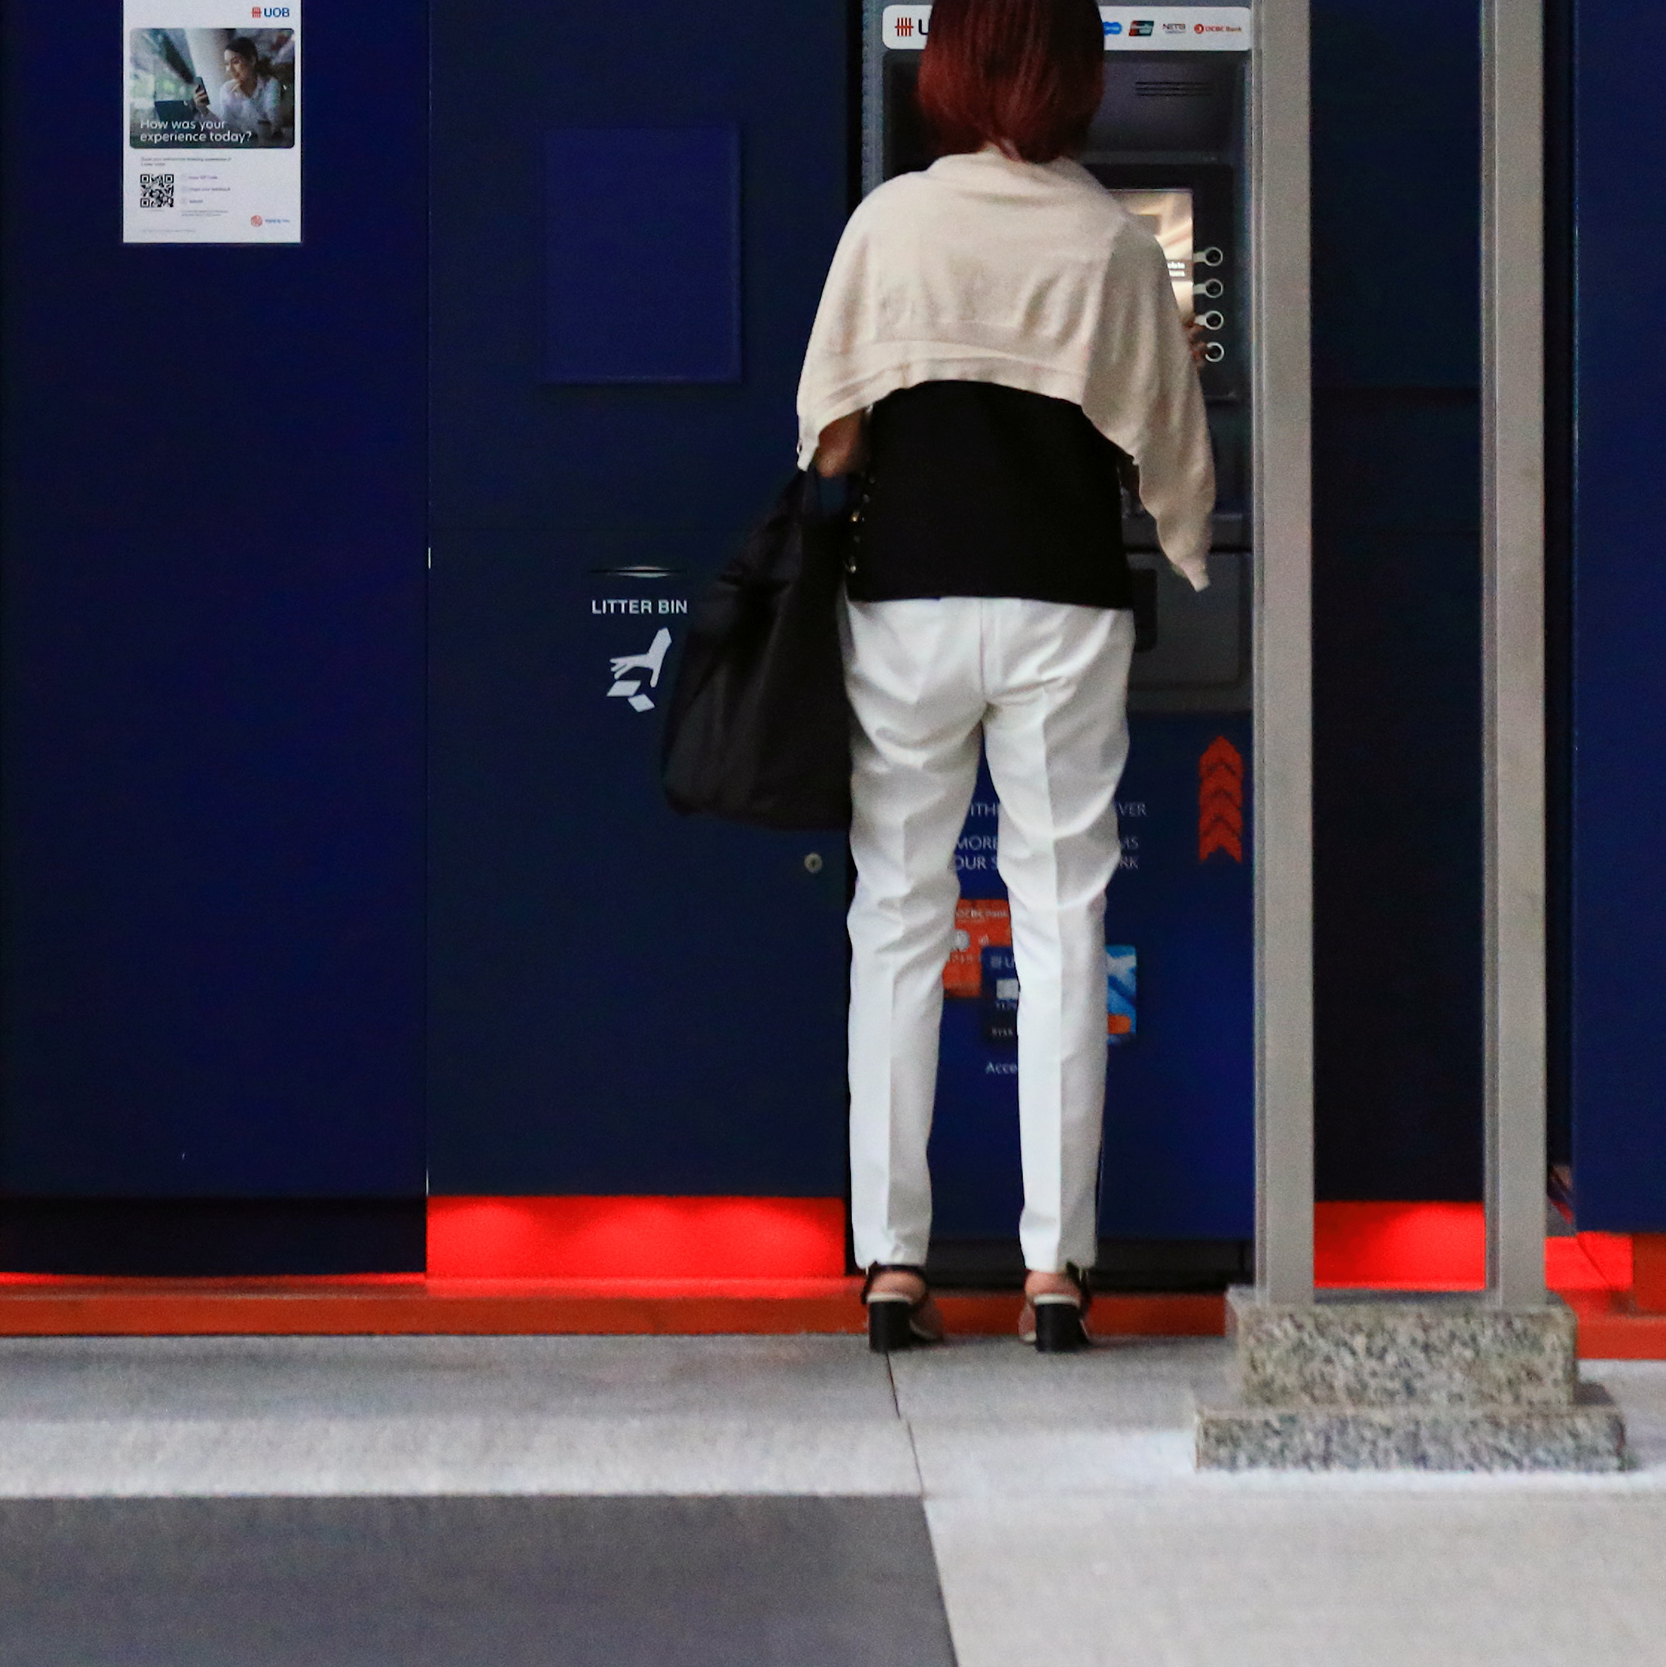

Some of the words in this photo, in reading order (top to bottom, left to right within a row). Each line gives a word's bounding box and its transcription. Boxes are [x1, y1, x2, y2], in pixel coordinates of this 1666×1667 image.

[263, 7, 290, 18] UOB
[140, 119, 169, 129] How
[171, 121, 196, 129] was
[199, 120, 226, 131] your
[140, 132, 207, 143] experience
[209, 131, 252, 143] today?
[591, 599, 653, 615] LITTER
[658, 599, 688, 615] BIN
